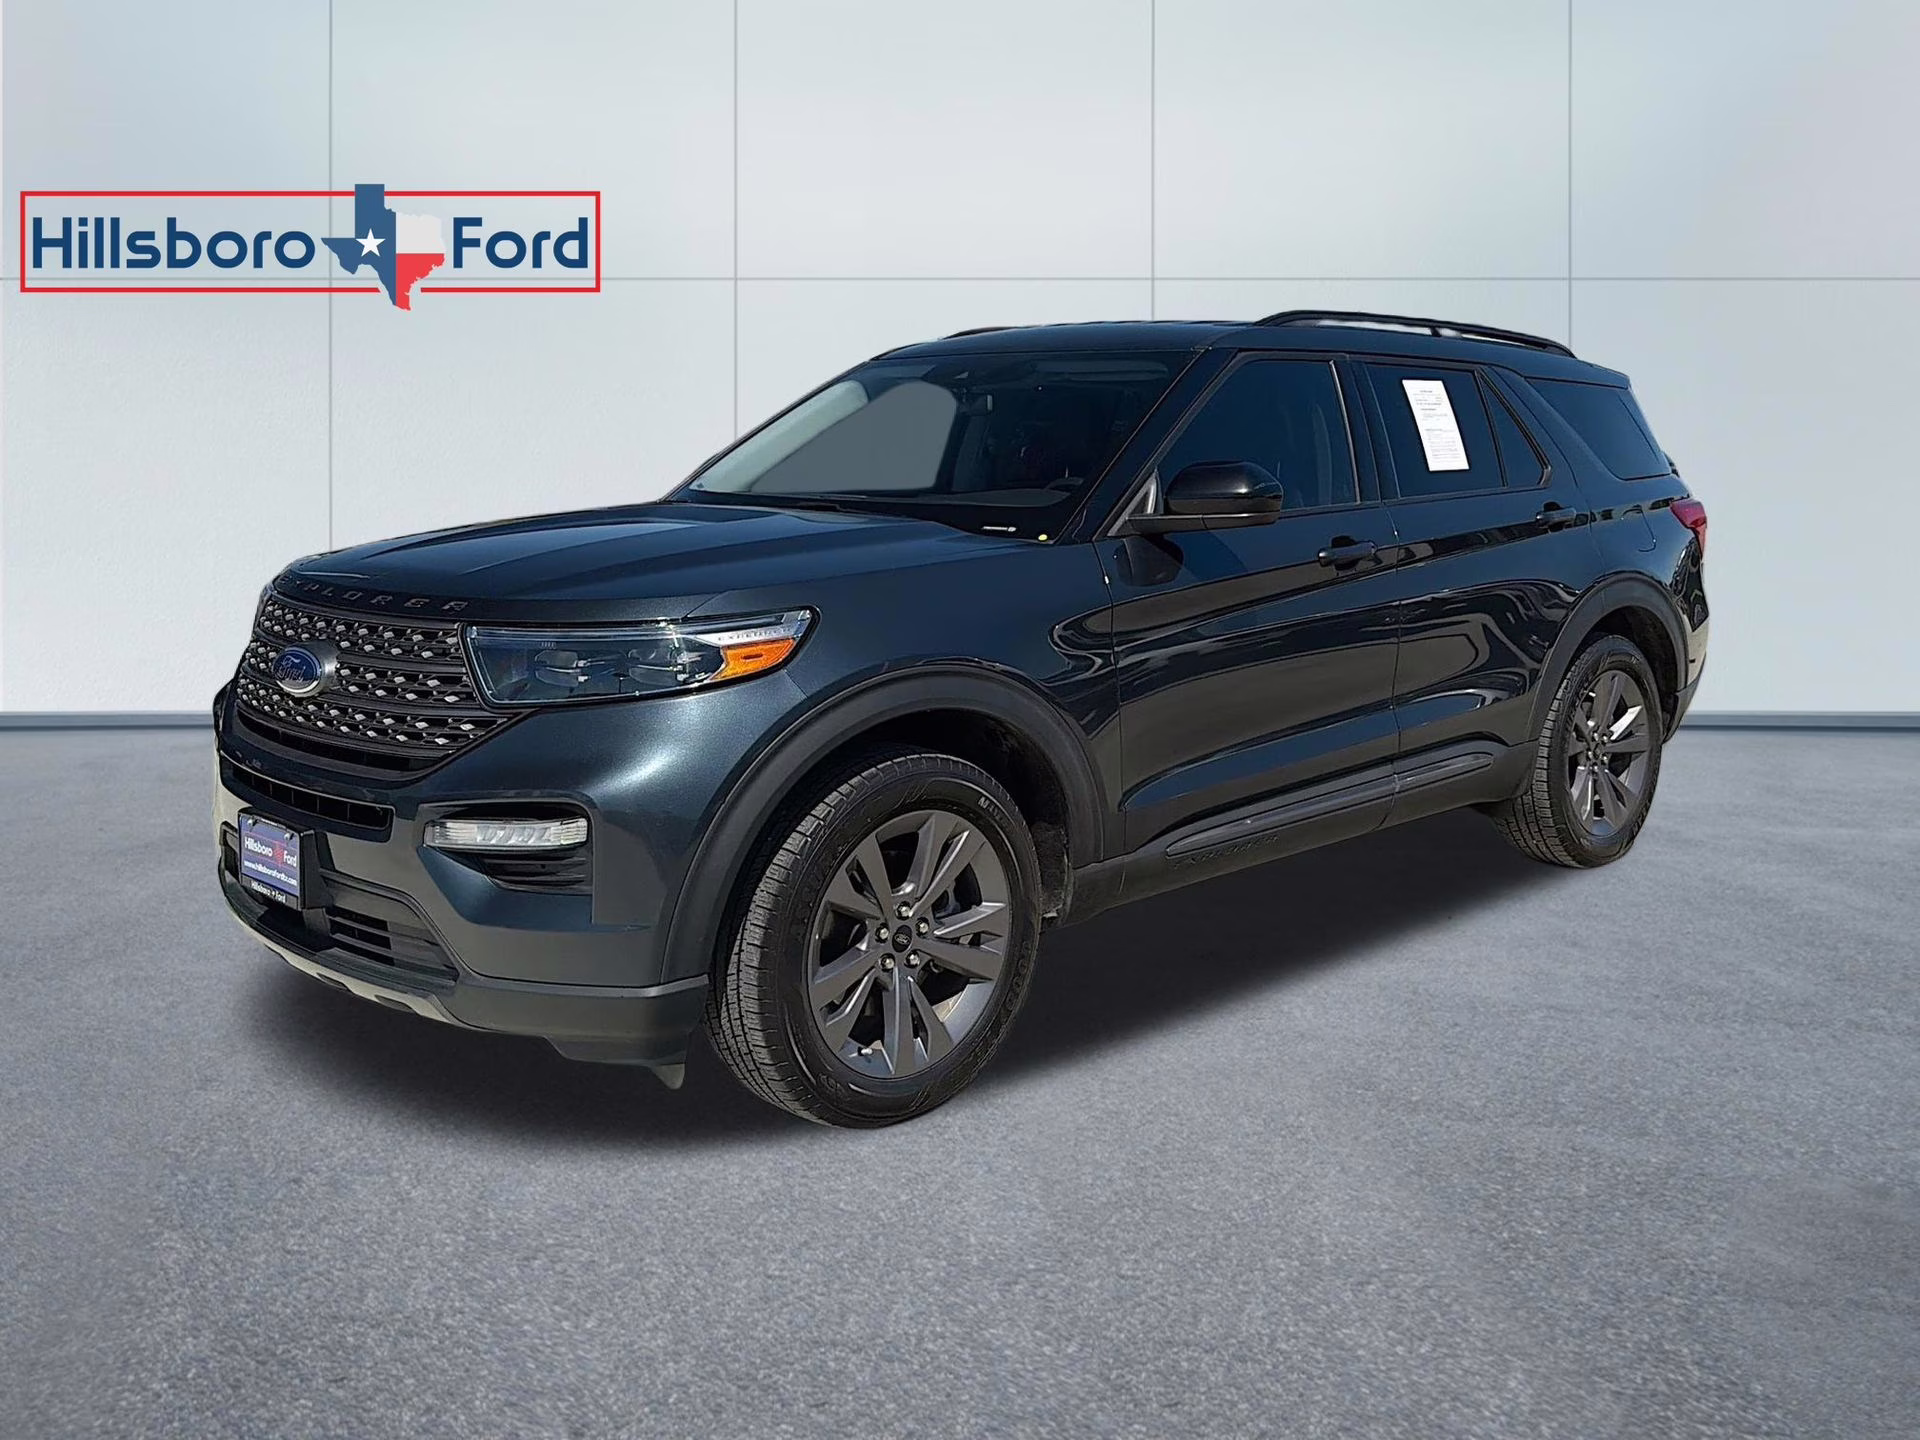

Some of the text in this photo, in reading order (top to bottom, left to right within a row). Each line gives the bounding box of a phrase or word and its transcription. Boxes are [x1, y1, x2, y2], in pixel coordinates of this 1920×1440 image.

[275, 655, 306, 683] Ford
[244, 836, 297, 867] Hillsboro Ford
